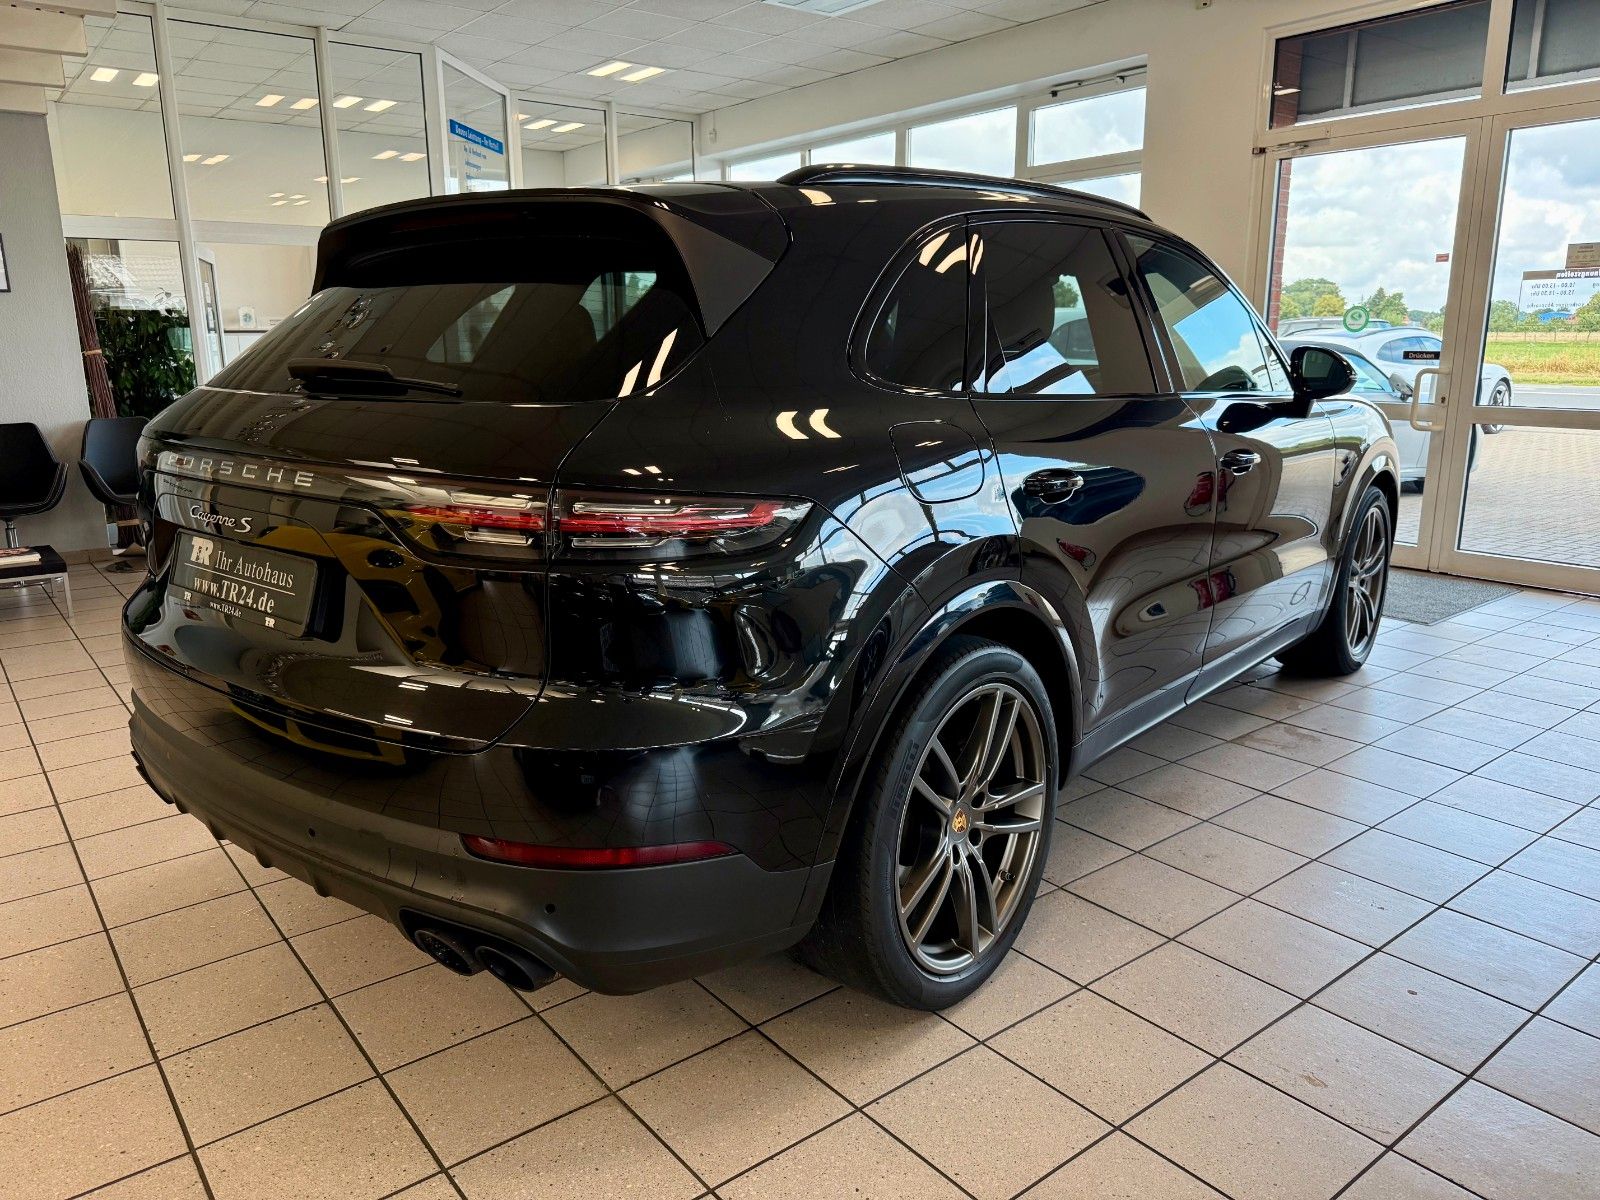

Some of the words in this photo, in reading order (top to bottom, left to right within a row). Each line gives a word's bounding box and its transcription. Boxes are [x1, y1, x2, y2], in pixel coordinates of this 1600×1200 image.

[167, 451, 314, 487] PORSCHE
[190, 505, 236, 528] Cayenne
[234, 517, 252, 533] S
[215, 550, 233, 572] Ihr
[233, 556, 294, 588] Autohaus
[193, 577, 275, 614] www.TR24.de
